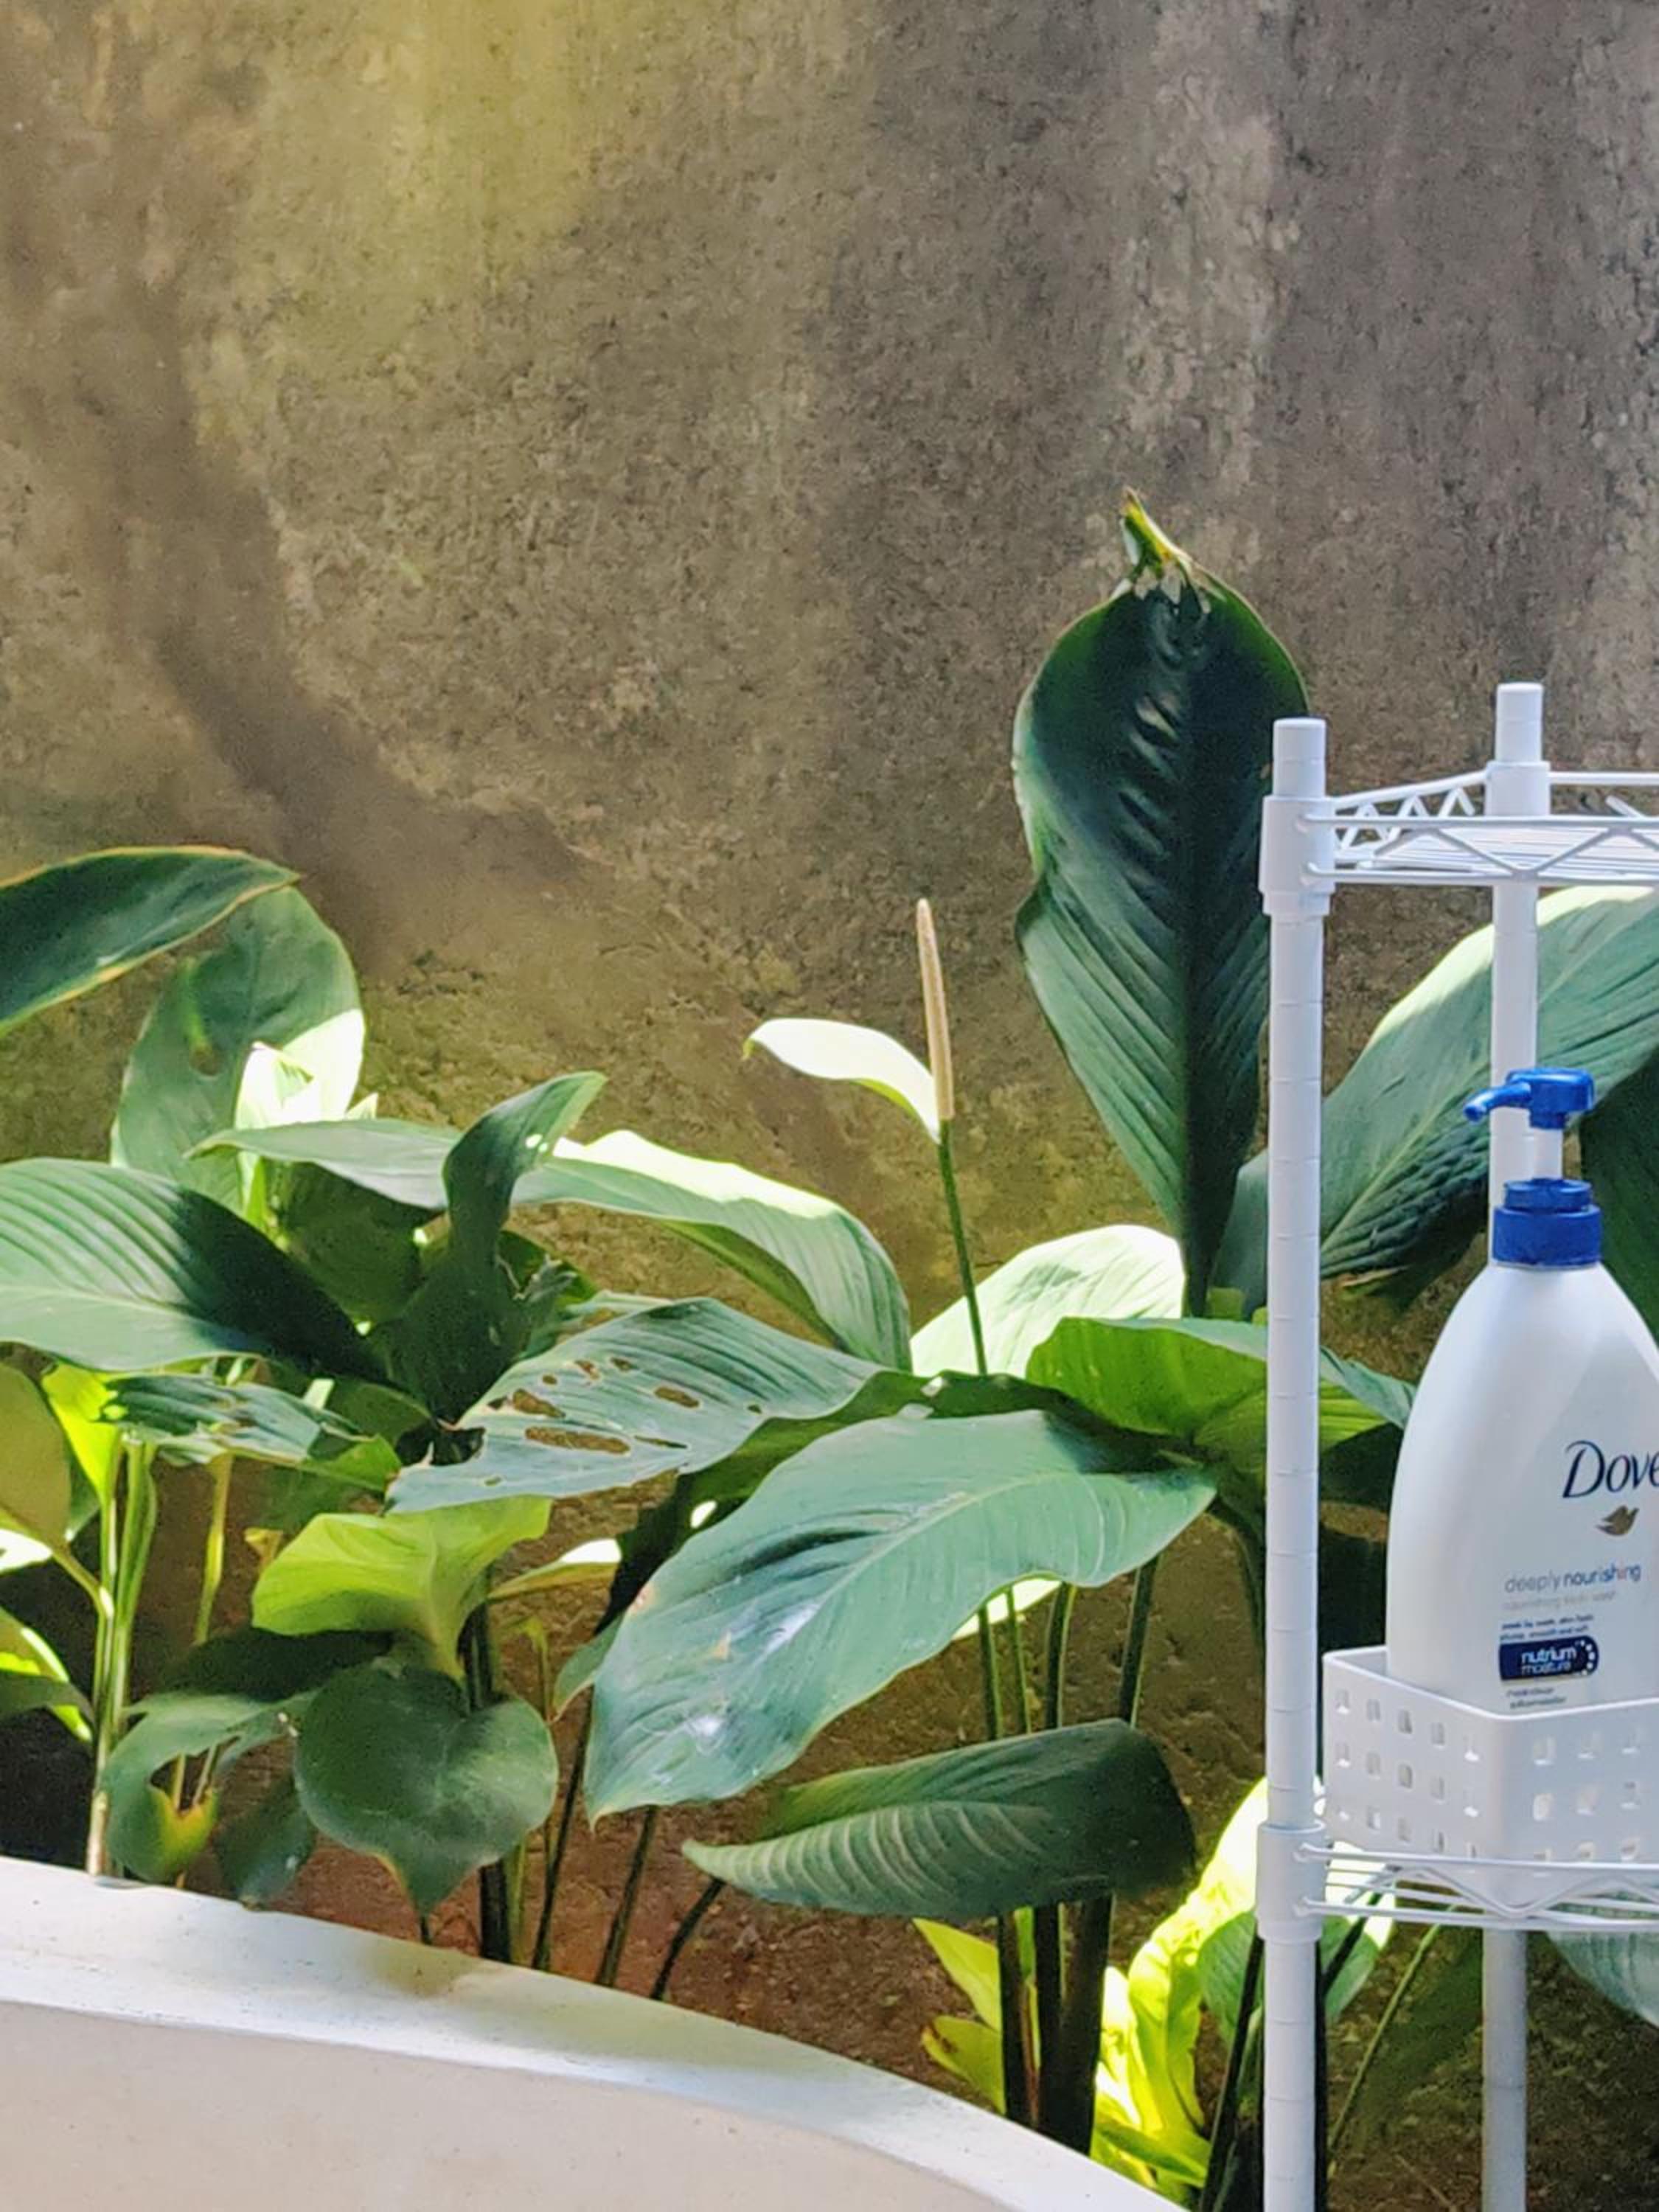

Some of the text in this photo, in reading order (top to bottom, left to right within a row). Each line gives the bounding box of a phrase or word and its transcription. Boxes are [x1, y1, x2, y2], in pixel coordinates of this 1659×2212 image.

[1562, 1439, 1659, 1498] Dove
[1504, 1562, 1641, 1593] deeply nourishing
[1521, 1646, 1577, 1663] nutrium
